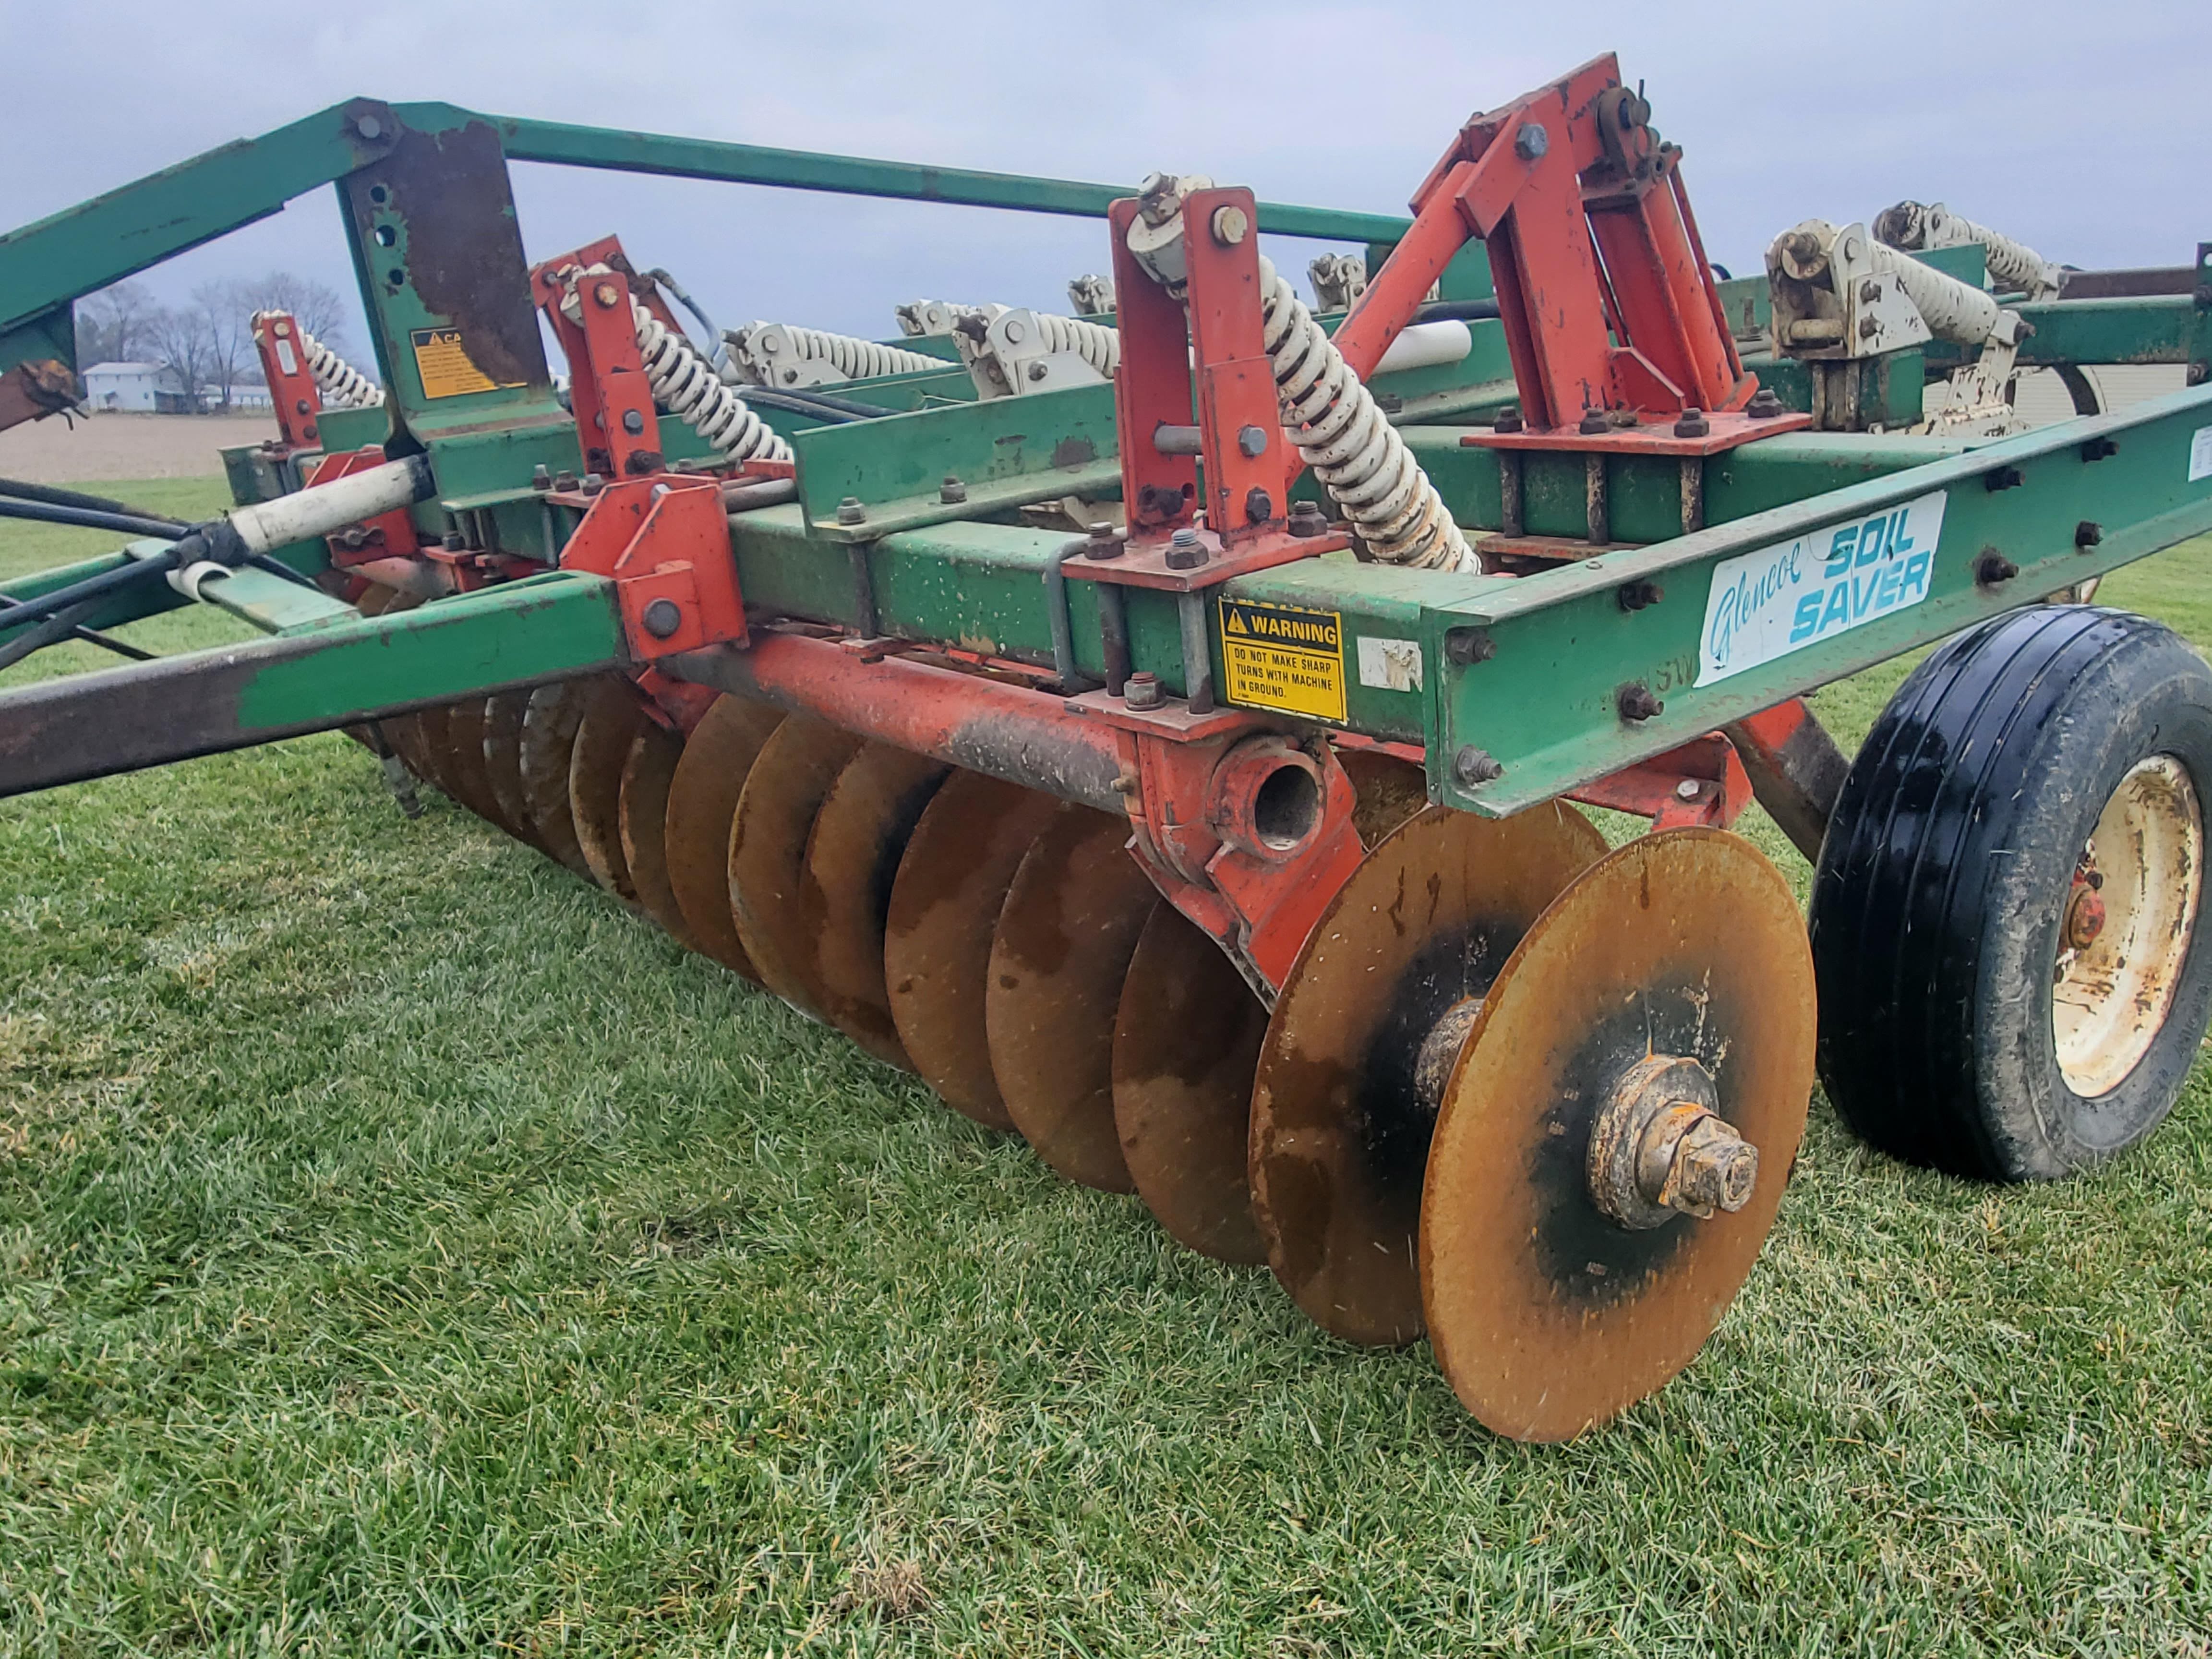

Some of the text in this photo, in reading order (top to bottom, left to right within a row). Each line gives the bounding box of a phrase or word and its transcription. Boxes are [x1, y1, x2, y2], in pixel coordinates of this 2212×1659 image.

[1825, 508, 1914, 579] SOIL
[1790, 550, 1931, 644] SAVER
[1250, 614, 1337, 645] WARNING
[1234, 648, 1331, 674] DO NOT MAKE SHARP
[1236, 663, 1333, 691] TURNS WITH MACHINE
[1238, 680, 1246, 690] IN
[1249, 681, 1286, 698] GROUND.
